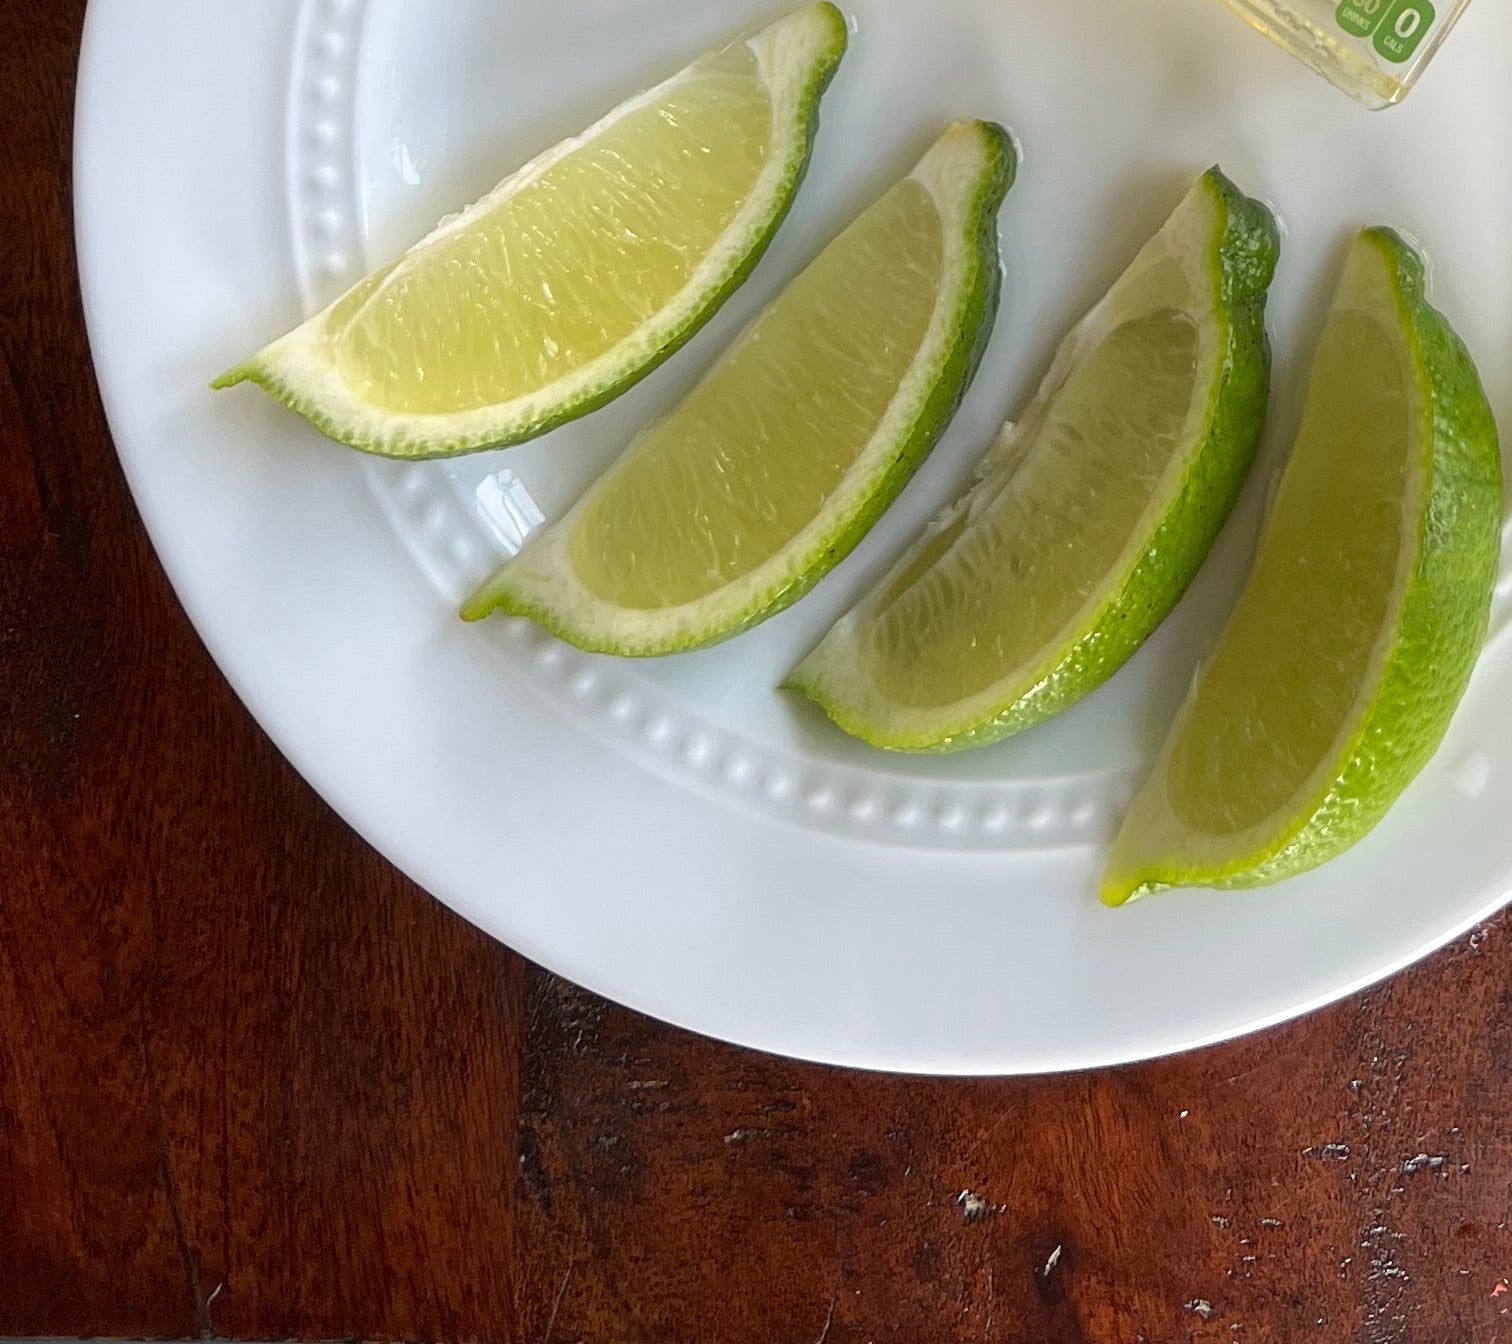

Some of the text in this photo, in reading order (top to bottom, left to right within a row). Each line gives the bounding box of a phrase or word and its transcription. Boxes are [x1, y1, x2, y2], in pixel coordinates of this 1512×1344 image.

[1341, 5, 1371, 31] DRINKS
[1394, 7, 1421, 38] 0
[1383, 35, 1405, 54] CALS
